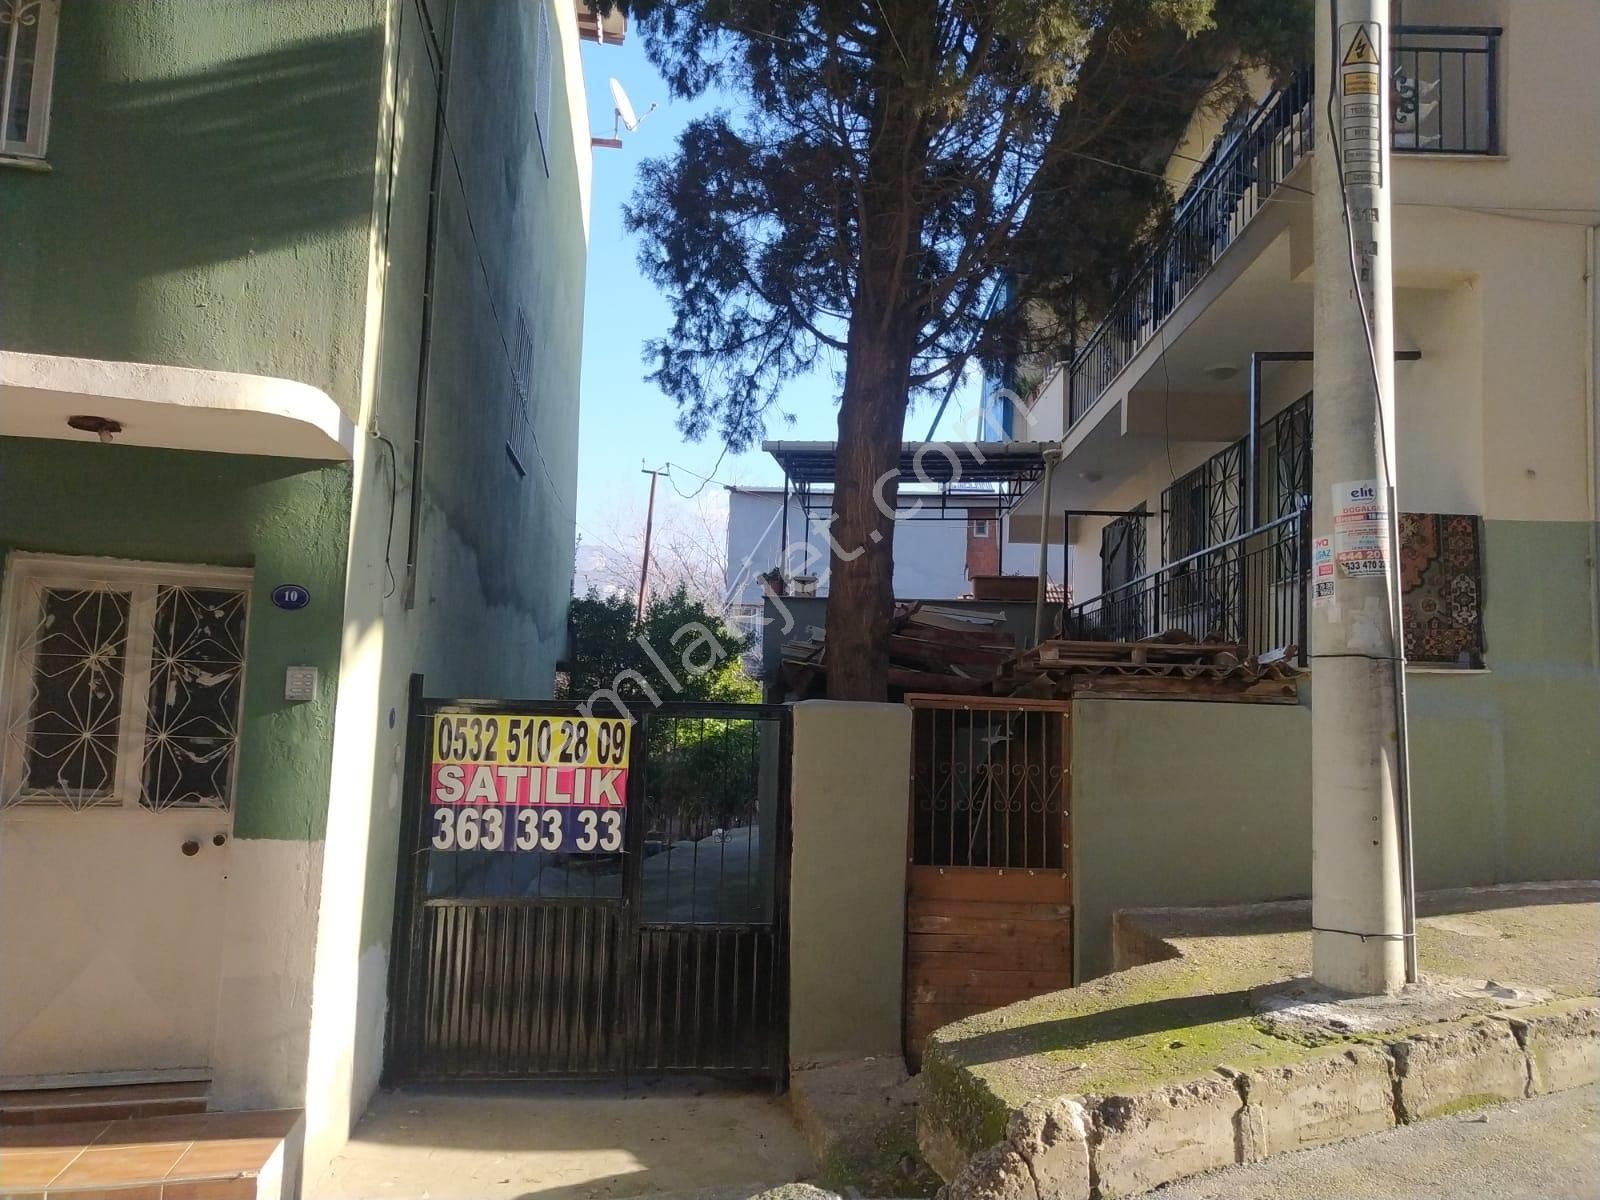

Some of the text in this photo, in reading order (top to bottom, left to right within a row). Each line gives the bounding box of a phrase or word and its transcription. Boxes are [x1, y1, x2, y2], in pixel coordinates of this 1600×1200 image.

[1350, 487, 1374, 498] elit
[1362, 560, 1377, 569] 470
[284, 590, 299, 602] 10
[438, 717, 626, 765] 0532 510 28 09
[435, 764, 624, 806] SATILIK
[432, 807, 622, 851] 363 33 33
